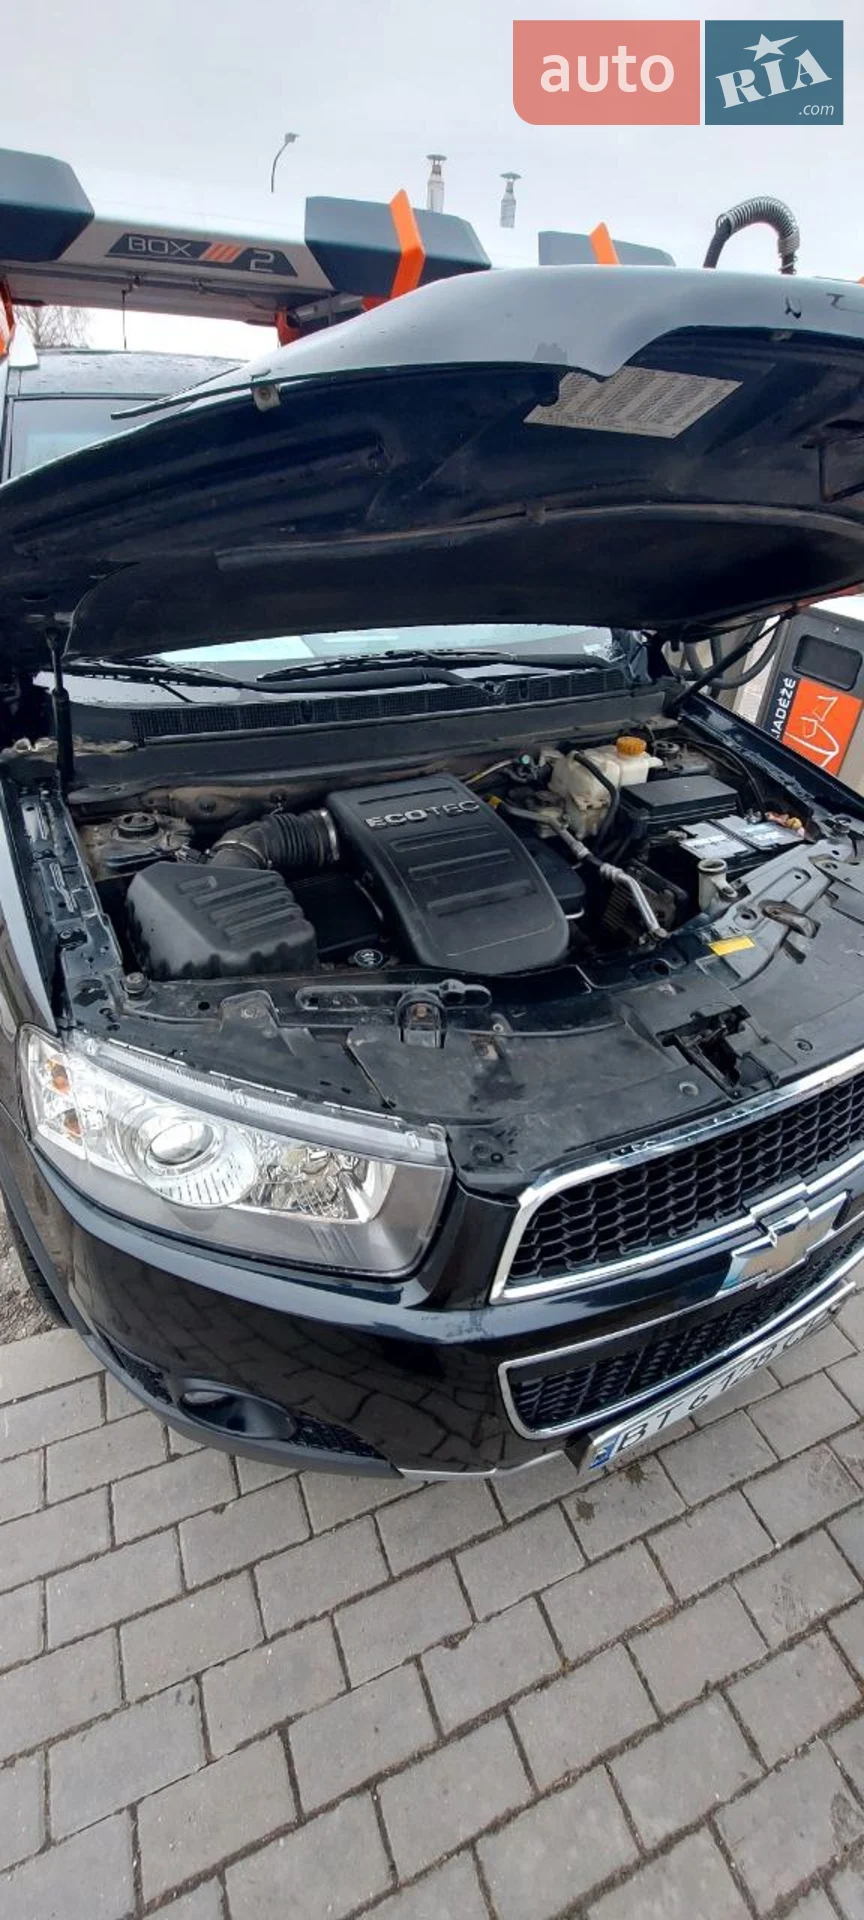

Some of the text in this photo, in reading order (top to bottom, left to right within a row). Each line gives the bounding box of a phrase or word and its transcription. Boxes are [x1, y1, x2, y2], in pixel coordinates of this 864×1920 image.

[128, 236, 275, 273] BOX 2
[365, 800, 480, 829] ECOTEC
[617, 1400, 684, 1452] BT
[688, 1344, 777, 1410] 6128
